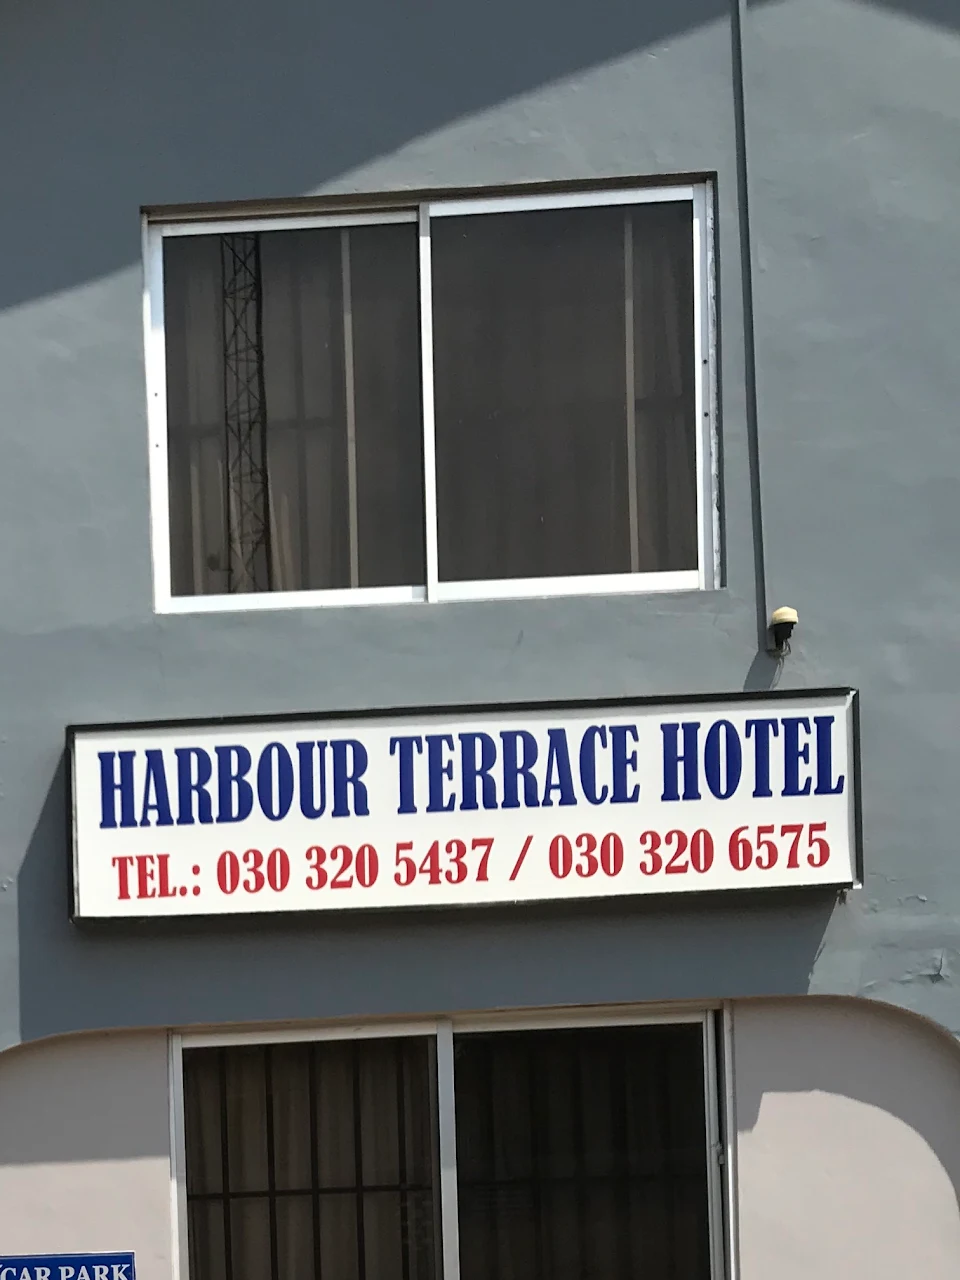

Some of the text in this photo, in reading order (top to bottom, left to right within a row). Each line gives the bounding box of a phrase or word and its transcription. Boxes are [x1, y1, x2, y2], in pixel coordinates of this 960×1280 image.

[99, 715, 845, 829] HARBOUR TERRACE HOTEL
[112, 822, 830, 900] TEL.: 030 320 5437 / 030 320 6575
